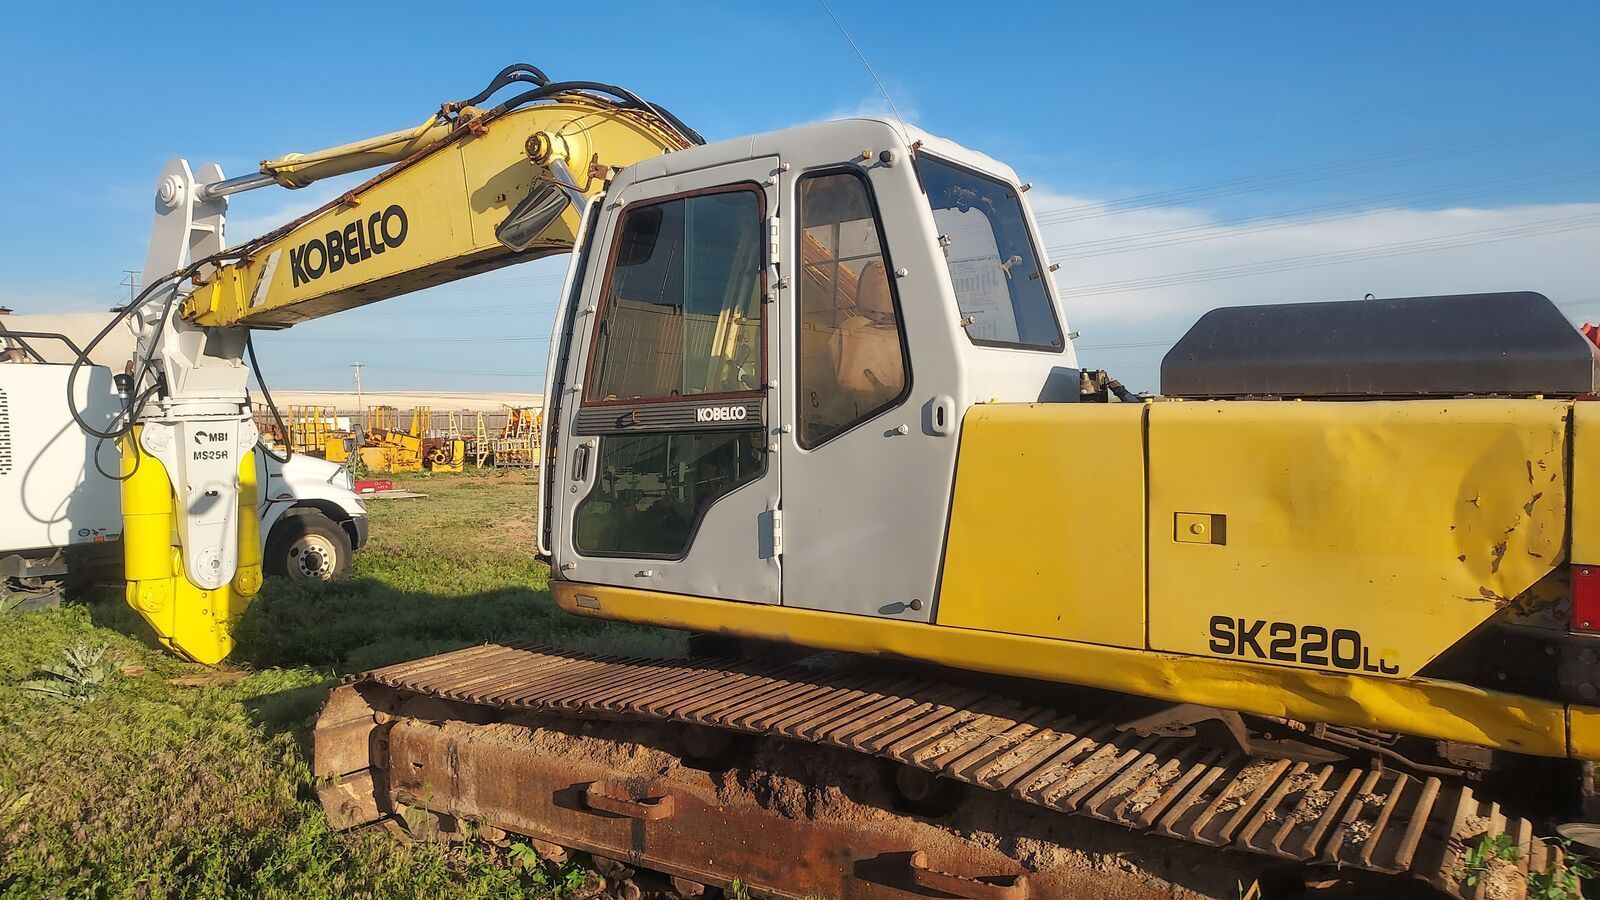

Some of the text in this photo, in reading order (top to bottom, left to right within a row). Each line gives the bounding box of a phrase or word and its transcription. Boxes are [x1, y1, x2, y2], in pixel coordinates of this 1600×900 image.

[289, 204, 408, 288] KOBELCO
[697, 406, 747, 422] KOBELCO
[208, 432, 228, 442] MBI
